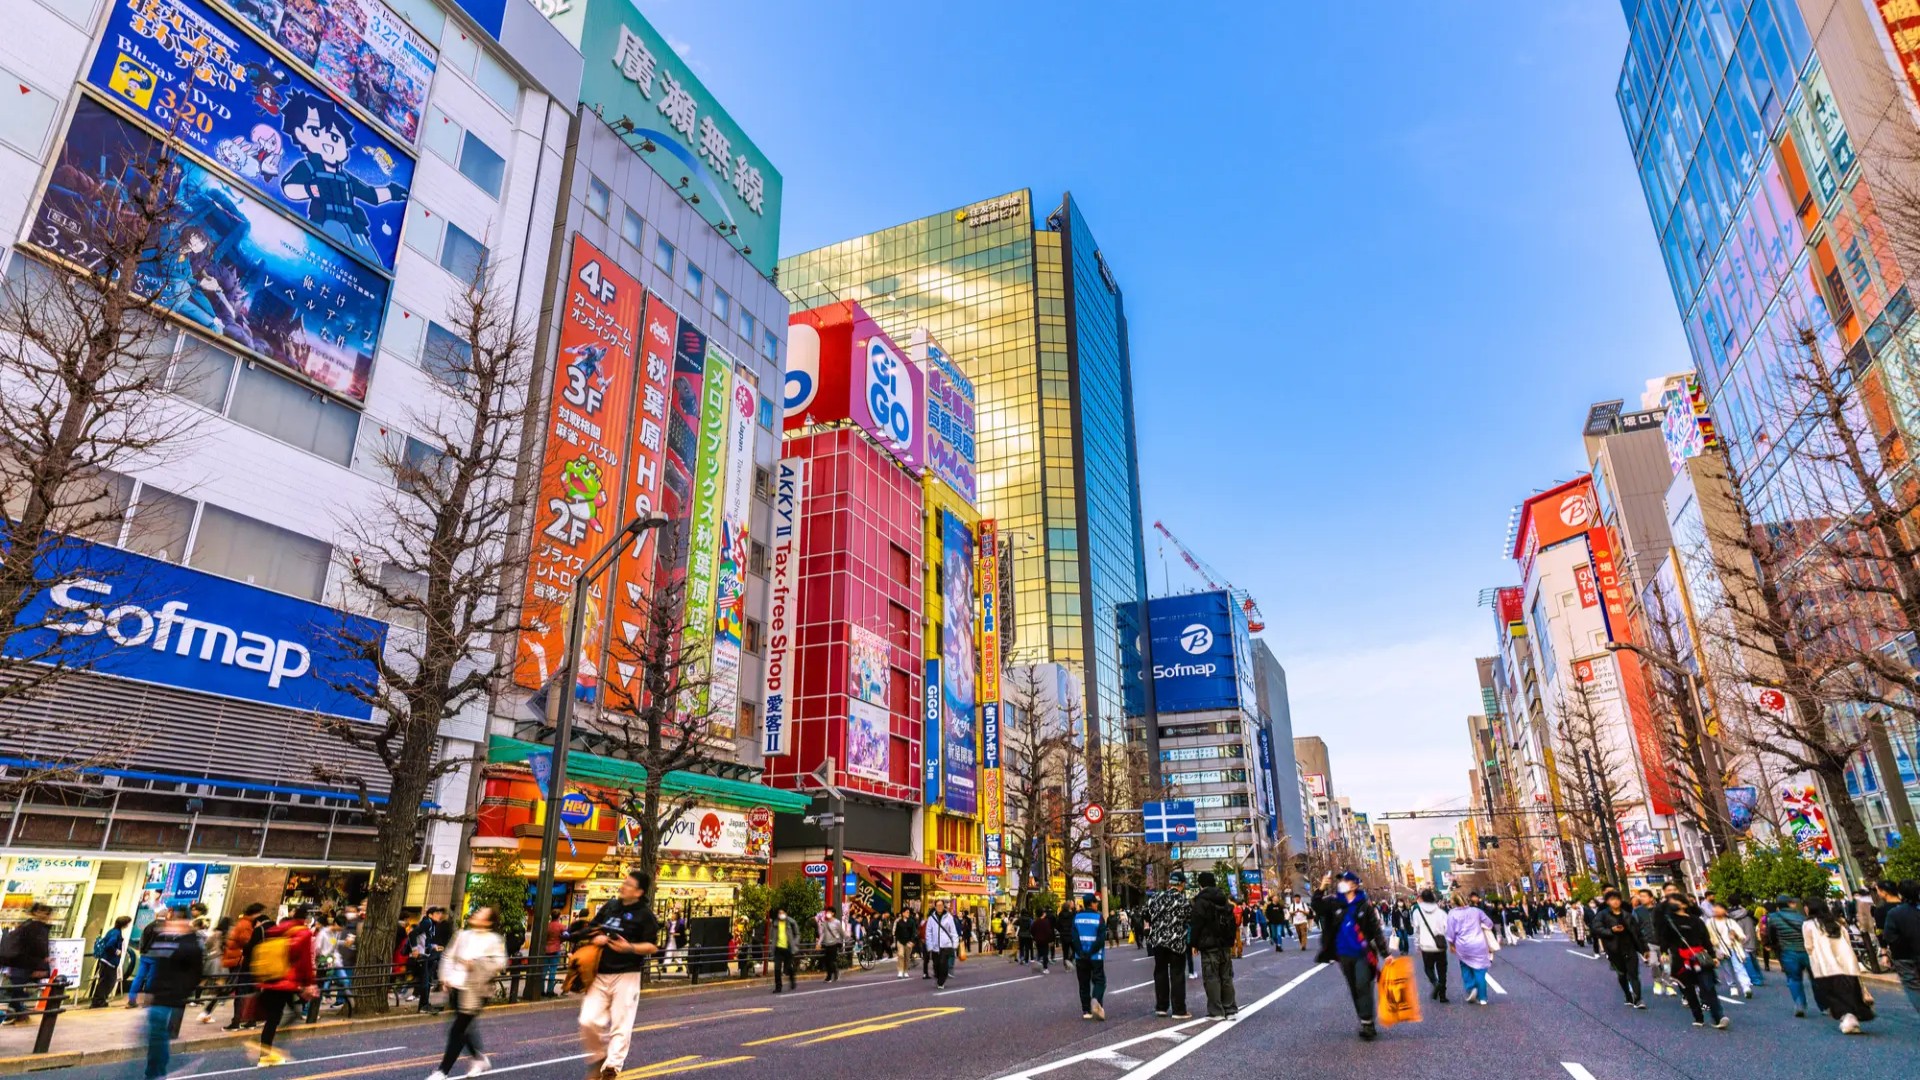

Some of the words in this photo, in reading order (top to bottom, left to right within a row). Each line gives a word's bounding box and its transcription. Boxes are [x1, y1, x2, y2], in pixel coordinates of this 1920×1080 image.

[117, 33, 176, 82] Blu-ray
[382, 10, 403, 33] Best
[404, 30, 434, 60] Album
[180, 120, 208, 145] Sale
[578, 258, 617, 306] 4F
[570, 306, 632, 359] オンラインゲーム
[574, 291, 632, 343] カードゲーム
[561, 365, 604, 416] 3F
[778, 463, 794, 523] AKKY
[544, 498, 587, 547] 2F
[769, 540, 792, 631] Tax-free
[44, 578, 311, 688] Sofmap
[766, 633, 787, 692] Shop
[1153, 663, 1217, 680] Sofmap
[927, 684, 938, 720] GiGO
[563, 799, 591, 817] Hey
[1089, 809, 1099, 818] 50
[44, 858, 90, 869] らくらく買取
[806, 864, 828, 874] GiGO
